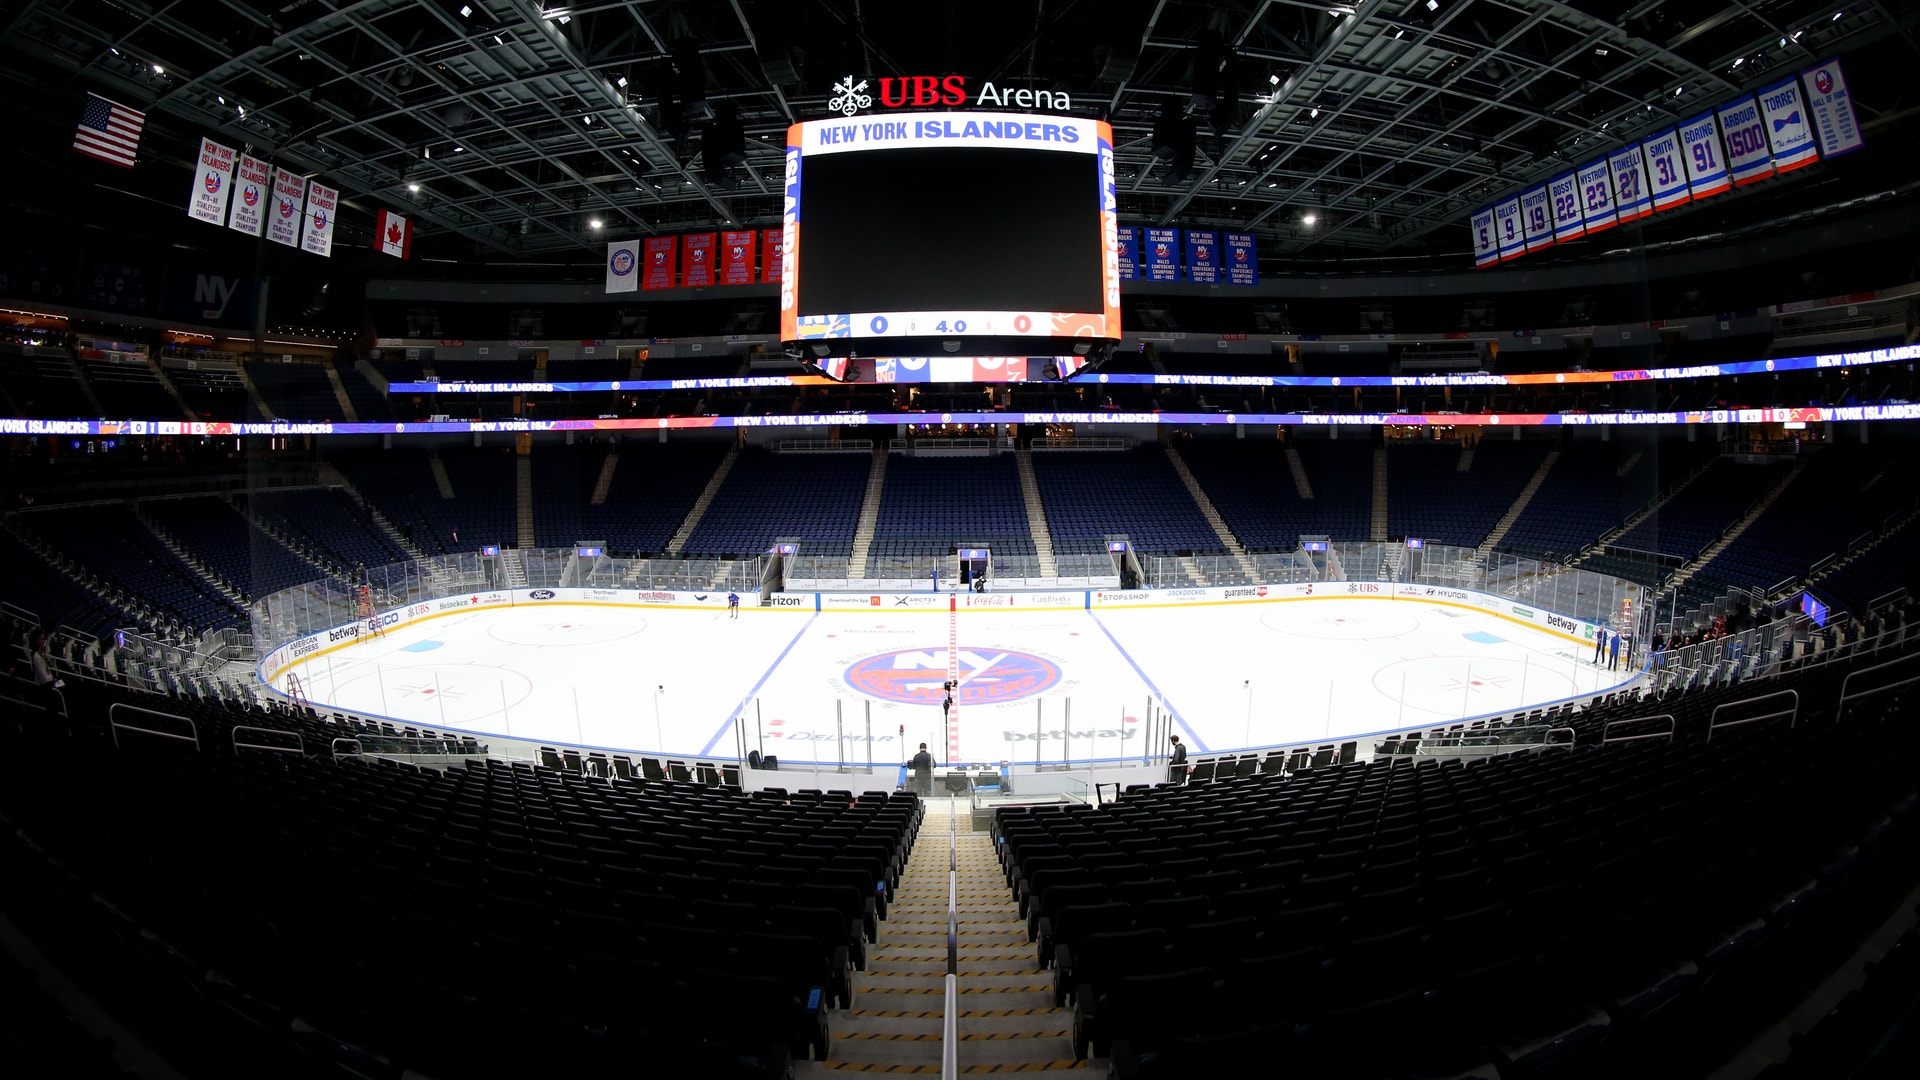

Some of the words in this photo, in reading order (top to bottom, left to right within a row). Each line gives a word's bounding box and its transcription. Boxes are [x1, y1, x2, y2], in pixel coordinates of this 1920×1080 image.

[878, 76, 966, 107] UBS
[976, 81, 1070, 111] Arena
[1764, 88, 1797, 112] TORREY
[1813, 98, 1826, 108] HALL
[1826, 94, 1832, 103] OF
[1834, 88, 1847, 100] FAME
[1724, 106, 1756, 128] ARBOUR
[820, 124, 857, 146] NEW
[862, 122, 908, 142] YORK
[914, 120, 1079, 144] ISLANDERS
[1684, 122, 1713, 144] GORING
[1726, 123, 1765, 159] 1500
[204, 142, 217, 155] NEW
[218, 146, 233, 161] YORK
[1650, 139, 1674, 158] SMITH
[1692, 140, 1716, 173] 91
[202, 154, 231, 172] ISLANDERS
[243, 157, 254, 169] NEW
[1612, 152, 1640, 172] TONELLI
[1656, 155, 1677, 186] 31
[279, 171, 289, 183] NEW
[290, 175, 304, 188] YORK
[1580, 167, 1607, 185] NYSTROM
[1619, 168, 1640, 200] 27
[277, 182, 302, 199] ISLANDERS
[313, 184, 322, 195] NEW
[1553, 180, 1573, 197] BOSSY
[1586, 181, 1608, 211] 23
[1522, 192, 1547, 209] TROTTIER
[1556, 194, 1576, 222] 22
[1498, 203, 1517, 219] GILLIES
[1529, 206, 1545, 232] 19
[1102, 146, 1121, 308] ISLANDERS
[1473, 214, 1491, 228] POTVIN
[1505, 218, 1515, 241] 9
[782, 149, 798, 312] ISLANDERS
[1480, 228, 1489, 250] 5
[870, 316, 888, 334] 0
[935, 320, 967, 333] 4.0
[1013, 314, 1031, 334] 0
[1816, 354, 1842, 367] NEW
[1843, 351, 1873, 365] YORK
[1154, 375, 1180, 384] NEW
[1182, 375, 1212, 384] YORK
[1213, 377, 1274, 386] ISLANDERS
[1392, 377, 1418, 385] NEW
[1420, 376, 1447, 385] YORK
[1448, 376, 1507, 384] ISLANDERS
[1613, 371, 1636, 381] NEW
[1638, 369, 1665, 380] YORK
[1666, 366, 1720, 378] ISLANDERS
[437, 384, 462, 392] NEW
[463, 383, 492, 392] YORK
[494, 383, 554, 392] ISLANDERS
[672, 380, 697, 389] NEW
[698, 379, 727, 388] YORK
[730, 377, 793, 387] ISLANDERS
[734, 417, 761, 426] NEW
[763, 416, 796, 426] YORK
[798, 415, 868, 425] ISLANDERS
[1024, 414, 1052, 423] NEW
[1055, 413, 1090, 423] YORK
[1092, 413, 1159, 422] ISLANDERS
[1303, 415, 1329, 424] NEW
[1331, 415, 1362, 424] YORK
[1364, 415, 1427, 424] ISLANDERS
[1562, 414, 1588, 424] NEW
[1589, 414, 1617, 424] YORK
[1618, 412, 1677, 423] ISLANDERS
[1835, 407, 1863, 420] YORK
[28, 420, 89, 434] ISLANDERS
[243, 424, 272, 433] YORK
[274, 422, 333, 434] ISLANDERS
[470, 422, 496, 431] NEW
[499, 422, 529, 431] YORK
[530, 421, 594, 430] ISLANDERS
[533, 591, 551, 599] Ford
[1224, 587, 1256, 599] guaranteed
[1359, 584, 1379, 592] UBS
[1438, 589, 1468, 599] HYUNDAI
[415, 603, 430, 615] UBS
[439, 599, 468, 610] Heineken
[368, 612, 399, 630] GEICO
[1547, 613, 1577, 634] betway
[329, 625, 359, 642] betway
[290, 636, 318, 651] AMERICAN
[294, 643, 319, 657] EXPRESS
[1003, 726, 1137, 742] betway
